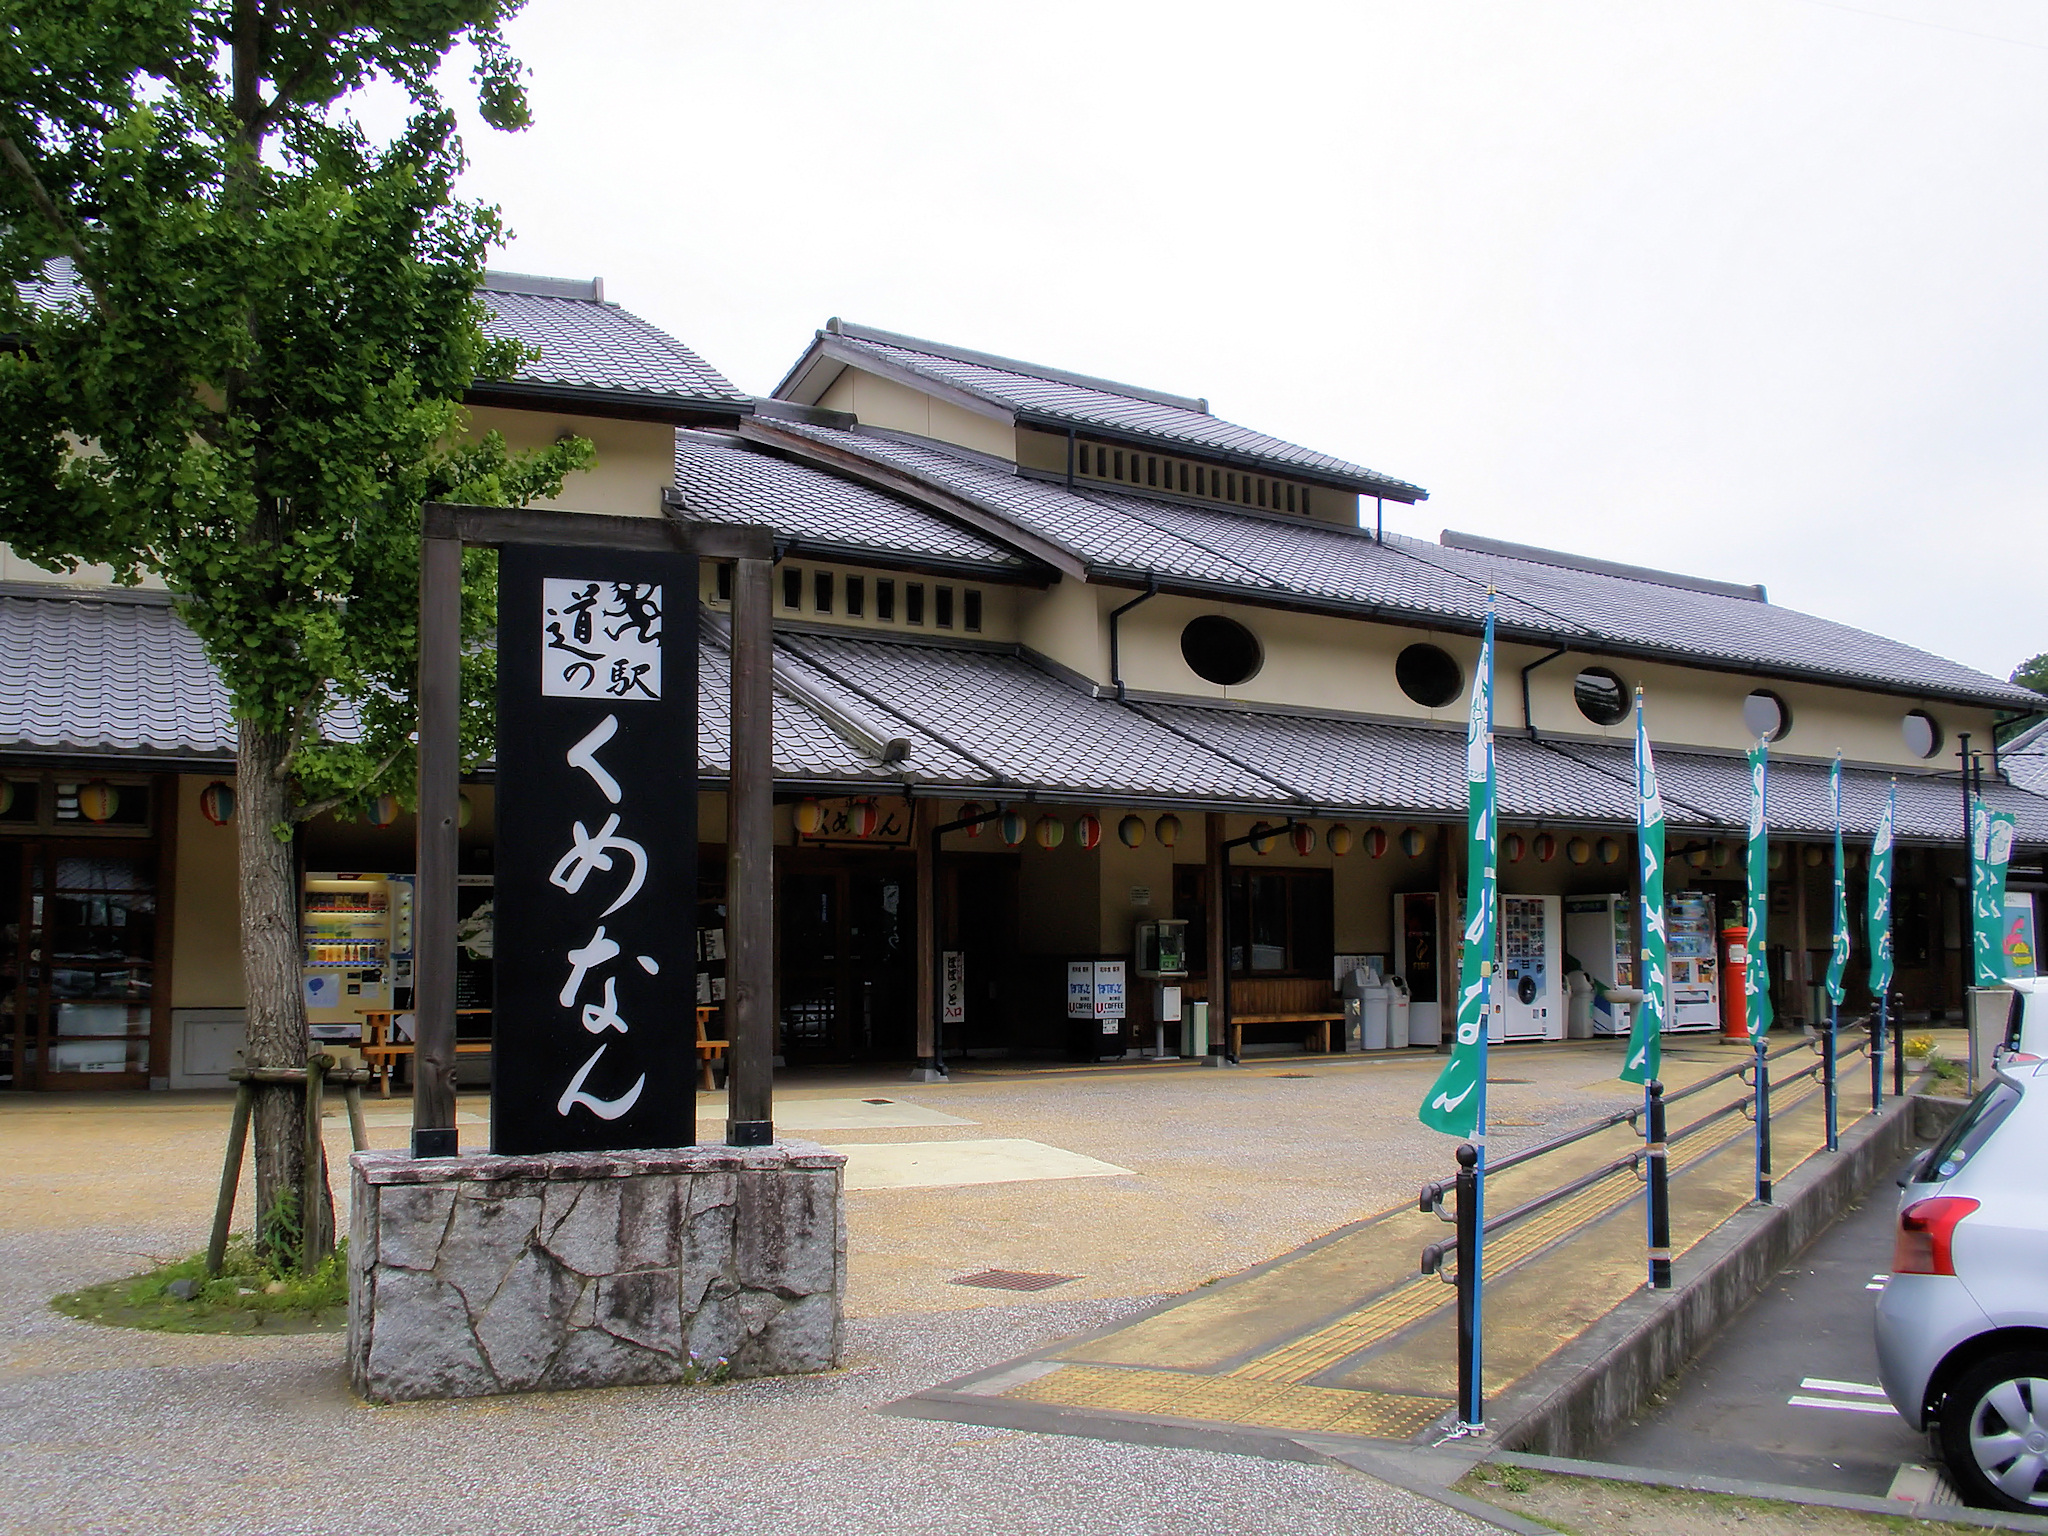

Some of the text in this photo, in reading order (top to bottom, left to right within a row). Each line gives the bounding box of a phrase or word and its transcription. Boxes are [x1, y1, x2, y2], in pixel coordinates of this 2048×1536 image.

[545, 583, 606, 691] 道の
[605, 658, 661, 699] 駅
[821, 807, 902, 836] くめん
[549, 712, 660, 1122] くめなん
[945, 1007, 962, 1017] 入口
